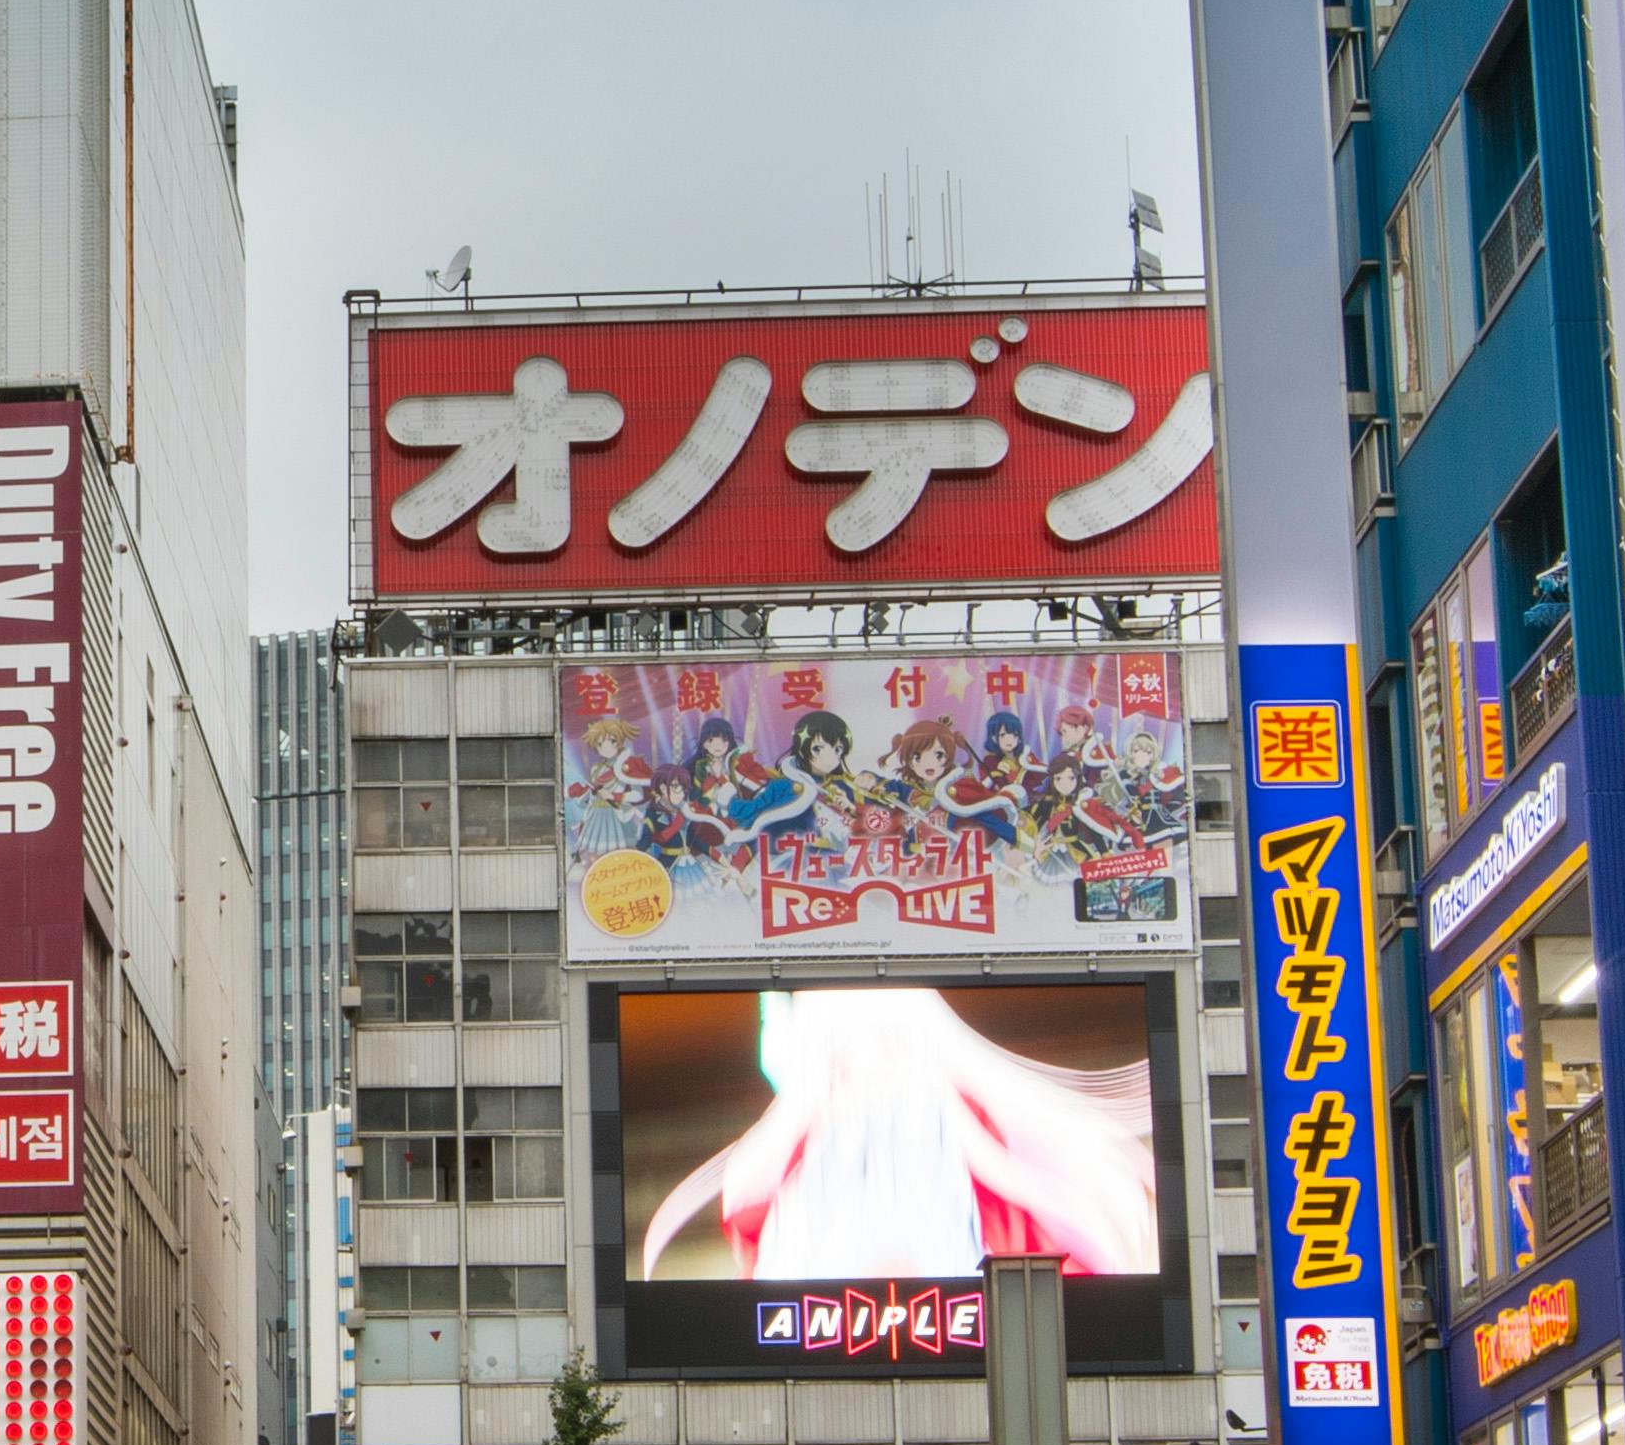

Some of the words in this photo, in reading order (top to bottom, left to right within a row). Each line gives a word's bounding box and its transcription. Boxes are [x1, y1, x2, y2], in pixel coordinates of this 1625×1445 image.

[384, 314, 1214, 555] オノデン
[1122, 673, 1162, 693] 今秋
[1263, 708, 1337, 781] 薬
[1432, 841, 1506, 944] Matsumoto
[1504, 774, 1558, 871] KiYoshi
[602, 893, 665, 933] 登場!
[905, 883, 988, 925] LIVE
[1499, 1309, 1532, 1370] Free
[1529, 1283, 1569, 1354] Shop
[1302, 1362, 1364, 1390] 免税
